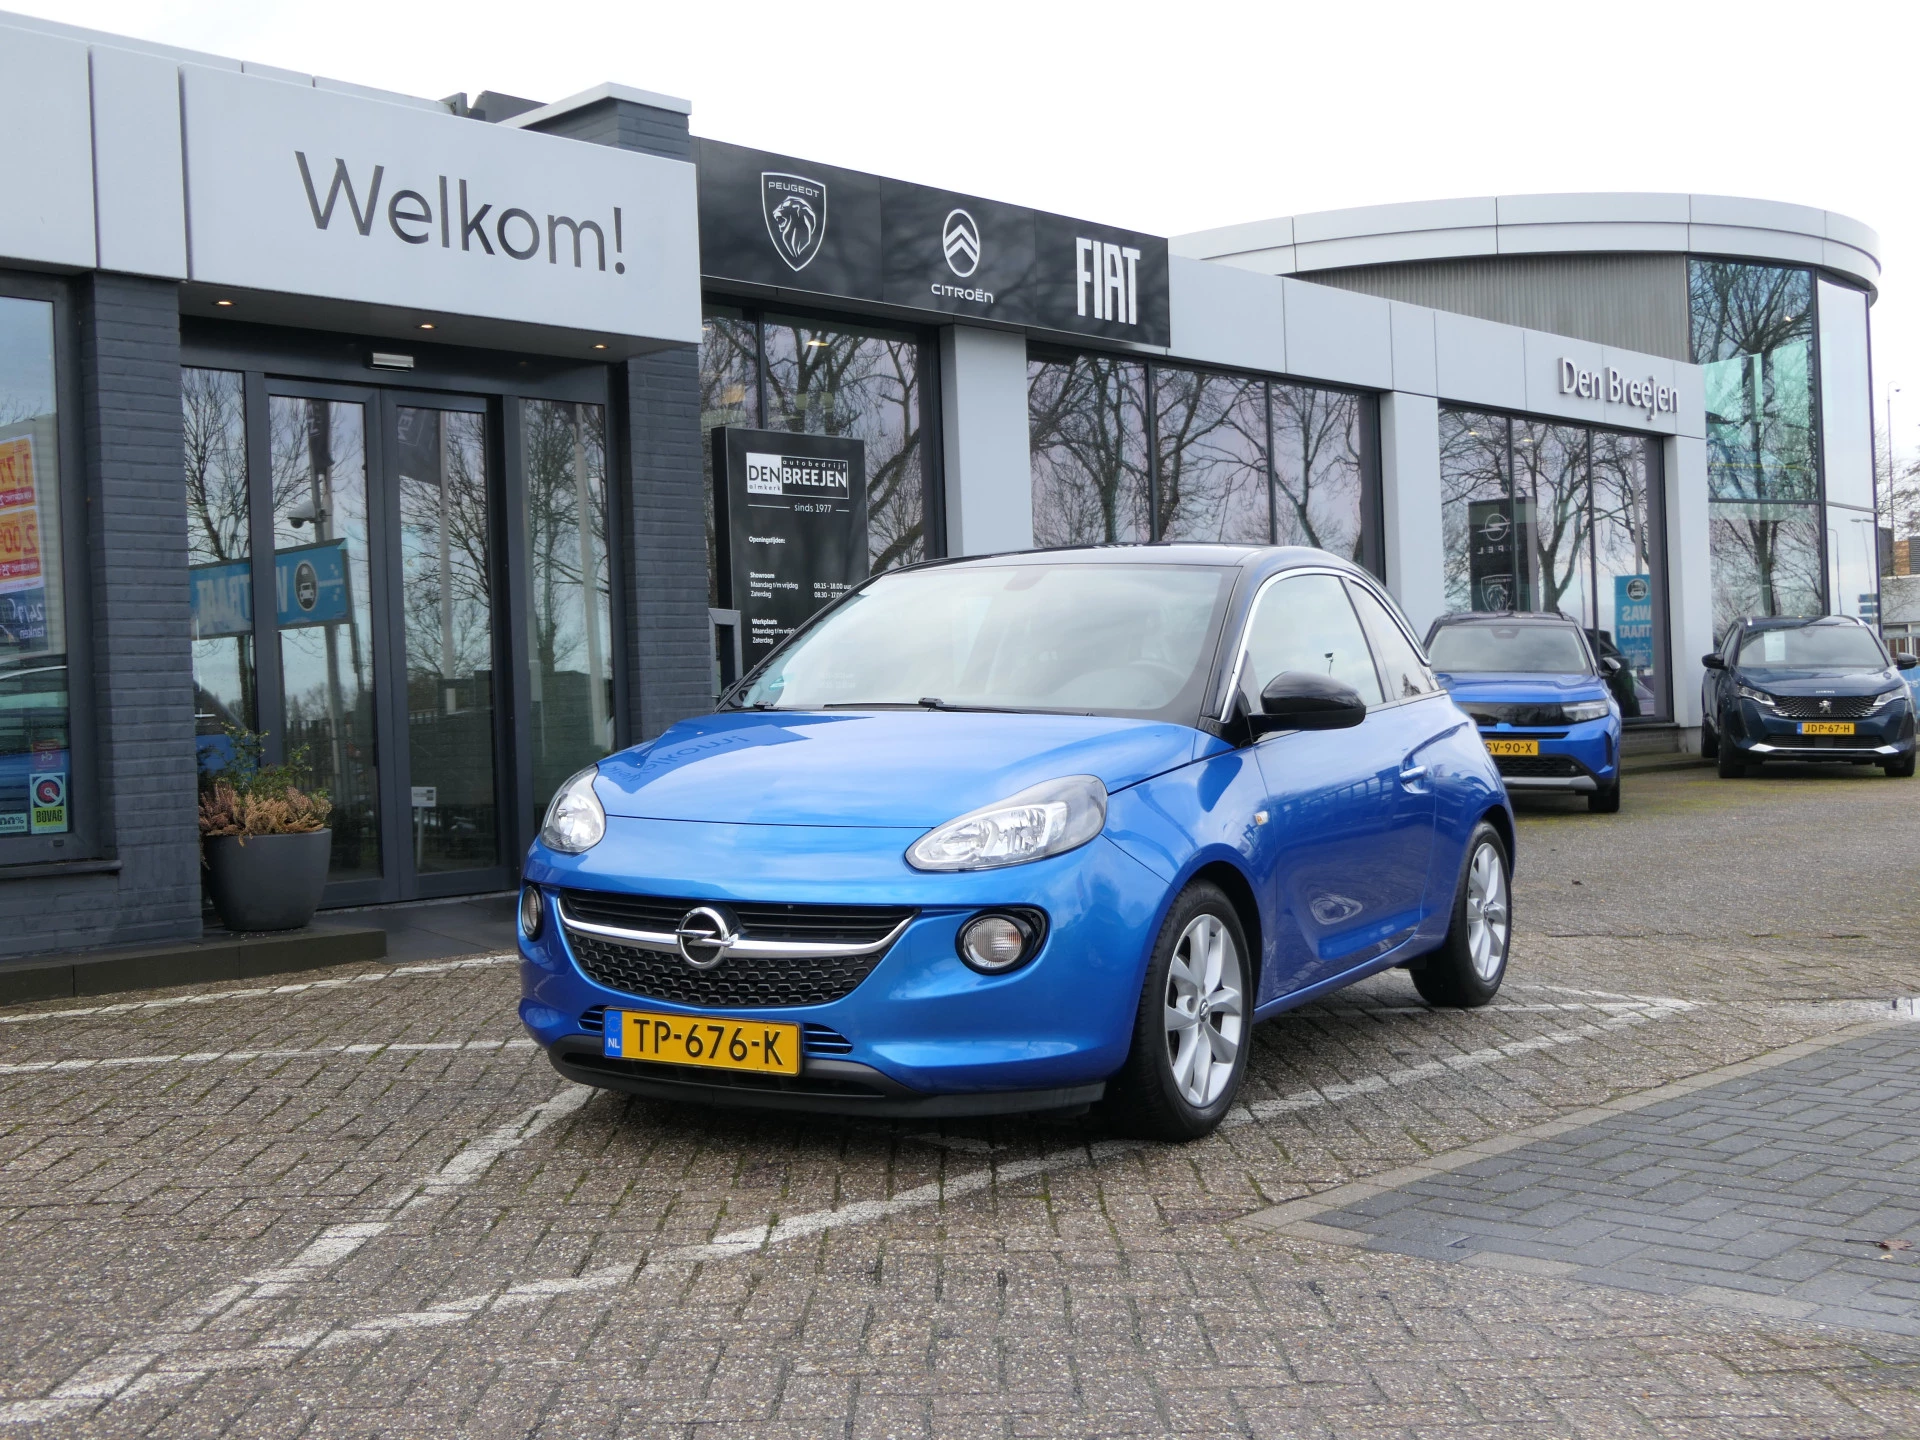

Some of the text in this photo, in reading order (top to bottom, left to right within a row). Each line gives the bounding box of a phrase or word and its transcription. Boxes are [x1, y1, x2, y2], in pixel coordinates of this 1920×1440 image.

[768, 181, 820, 198] PEUGEOT
[294, 150, 626, 275] Welkom!
[1076, 237, 1141, 325] FIAT
[930, 283, 994, 304] CITROËN
[1558, 357, 1679, 421] Den Breejen
[782, 460, 846, 470] autobedrijf
[748, 465, 847, 488] DEN BREEJEN
[794, 503, 832, 513] sinds 1977
[750, 581, 773, 589] Maandag
[782, 582, 798, 590] vrijdag
[750, 590, 772, 598] Zaterdag
[751, 618, 778, 626] Werkplaats
[752, 637, 774, 645] Zaterdag
[1805, 724, 1850, 733] JDP-67-H
[36, 810, 63, 823] BOVAG
[607, 1037, 621, 1049] NL
[632, 1018, 784, 1066] TP-676-K
